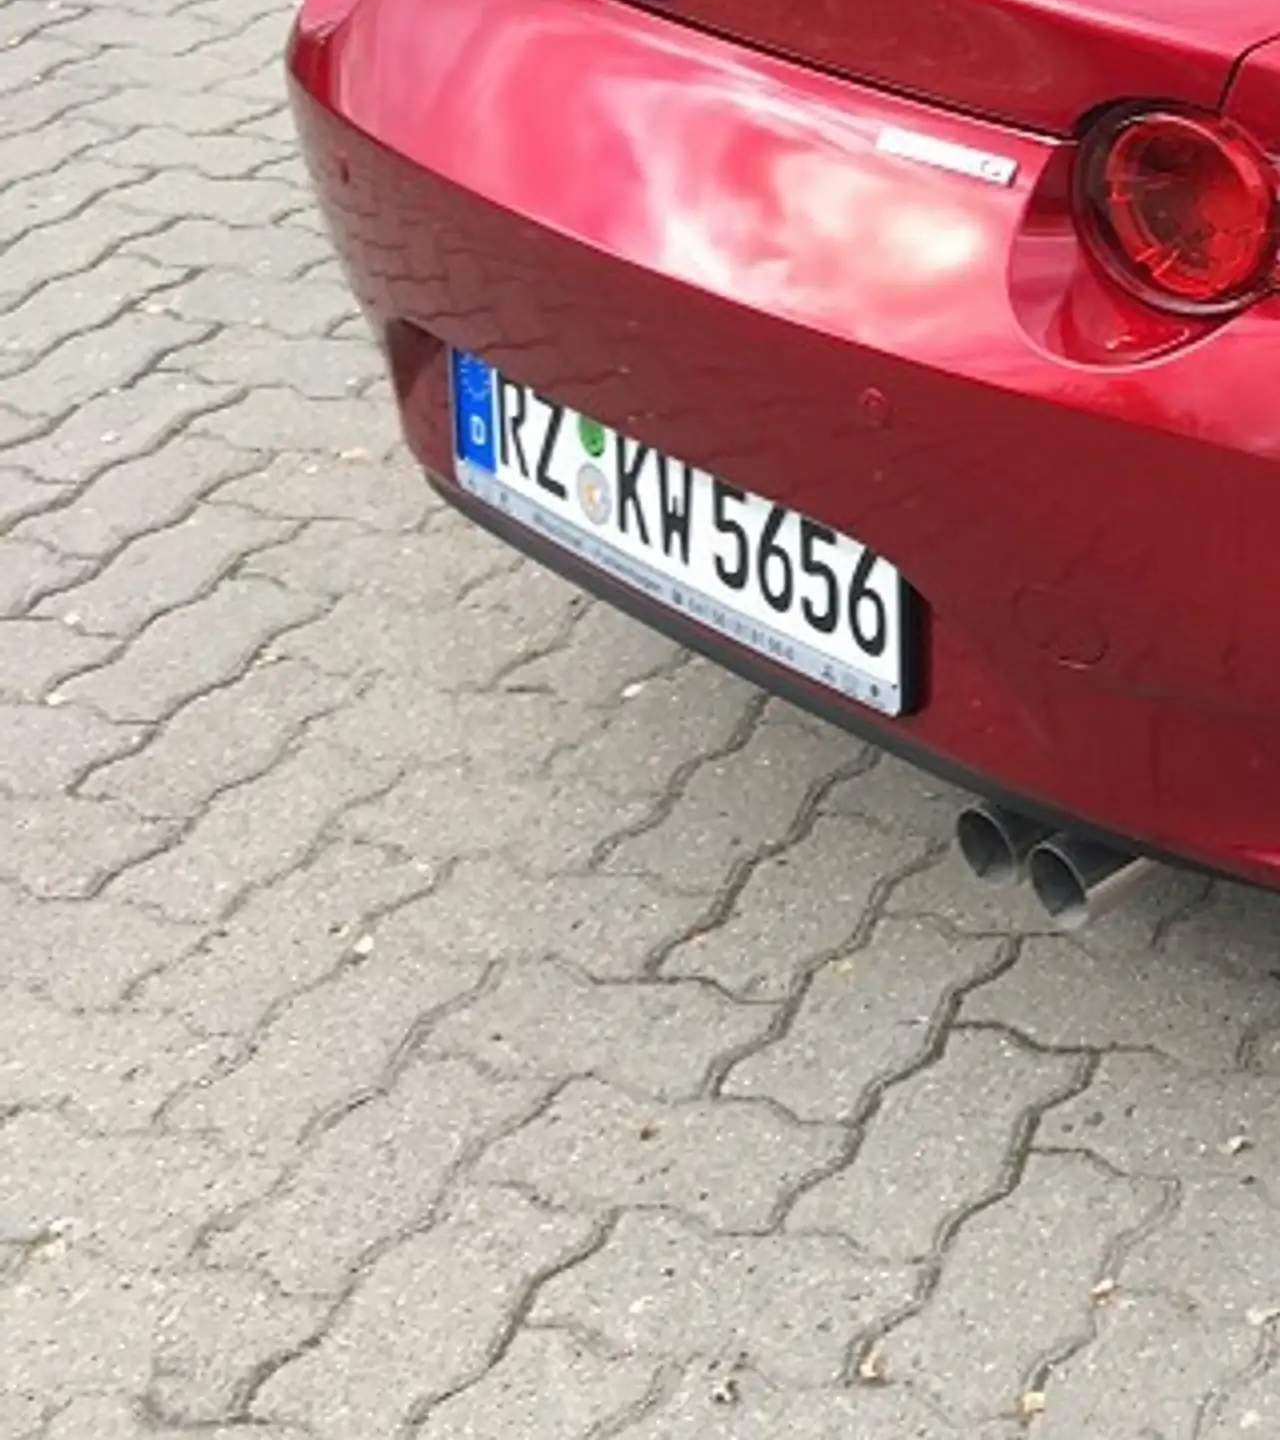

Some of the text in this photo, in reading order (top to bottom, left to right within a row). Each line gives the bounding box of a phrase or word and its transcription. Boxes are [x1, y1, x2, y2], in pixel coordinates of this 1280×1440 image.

[501, 372, 567, 500] RZ
[616, 435, 691, 566] KW
[712, 477, 887, 658] 5656
